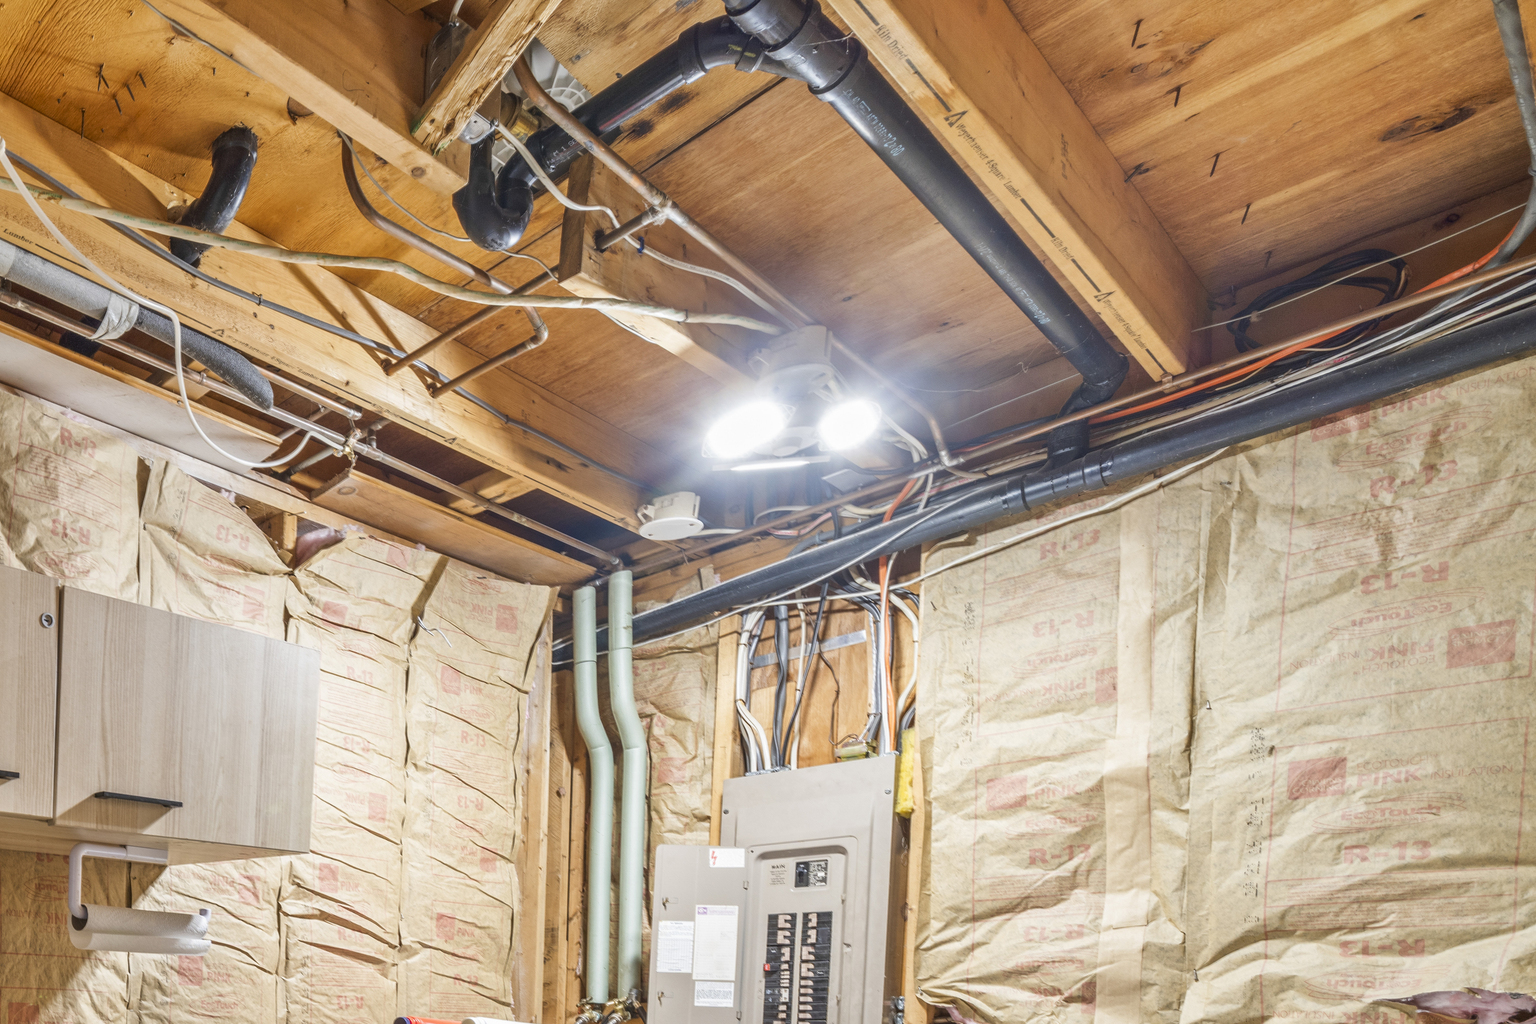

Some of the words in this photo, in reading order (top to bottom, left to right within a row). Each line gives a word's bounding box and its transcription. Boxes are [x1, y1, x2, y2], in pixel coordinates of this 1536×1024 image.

[1381, 387, 1448, 417] PINK
[60, 427, 97, 458] R-13
[1366, 420, 1467, 455] EcoTouch
[1369, 460, 1458, 498] R-13
[51, 518, 91, 545] R-13
[216, 525, 249, 551] R-13
[1039, 529, 1101, 560] R-13
[1360, 560, 1450, 595] R-13
[1032, 610, 1095, 638] R-13
[1351, 601, 1453, 628] EcoTouch
[1368, 638, 1435, 663] PINK
[346, 666, 374, 684] R-13
[460, 730, 486, 747] R-13
[1356, 768, 1422, 788] PINK
[1430, 764, 1513, 780] INSULATION
[457, 795, 484, 811] R-13
[1034, 783, 1079, 801] PINK
[1340, 803, 1441, 820] EcoTouch
[1028, 844, 1092, 865] R-13
[1342, 840, 1432, 864] R-13
[1023, 924, 1085, 942] R-13
[1339, 938, 1425, 958] R-13
[1326, 977, 1422, 991] EcoTouch
[336, 996, 364, 1010] R-13
